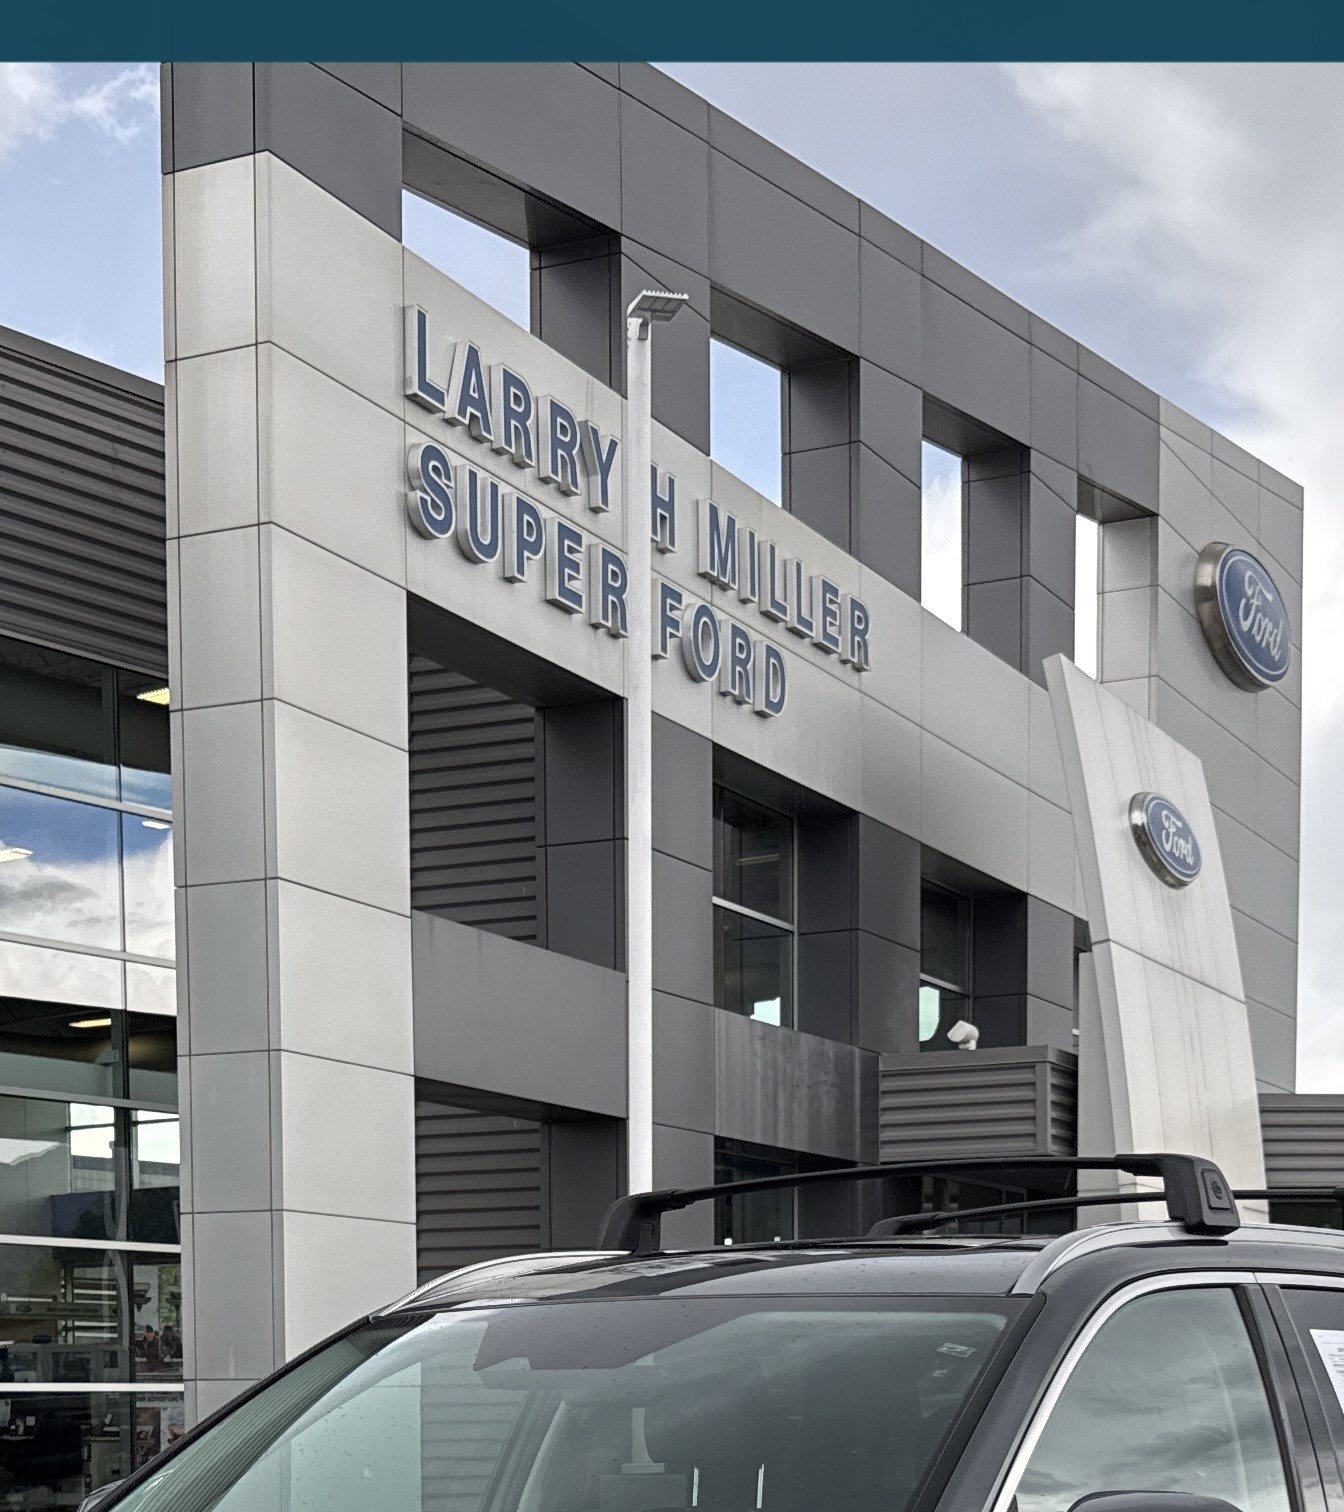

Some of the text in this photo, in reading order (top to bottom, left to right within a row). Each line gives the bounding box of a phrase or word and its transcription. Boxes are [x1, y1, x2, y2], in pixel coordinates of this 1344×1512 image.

[406, 304, 870, 673] LARRY H MILLER
[408, 442, 787, 719] SUPER FORD
[1238, 569, 1282, 662] Ford
